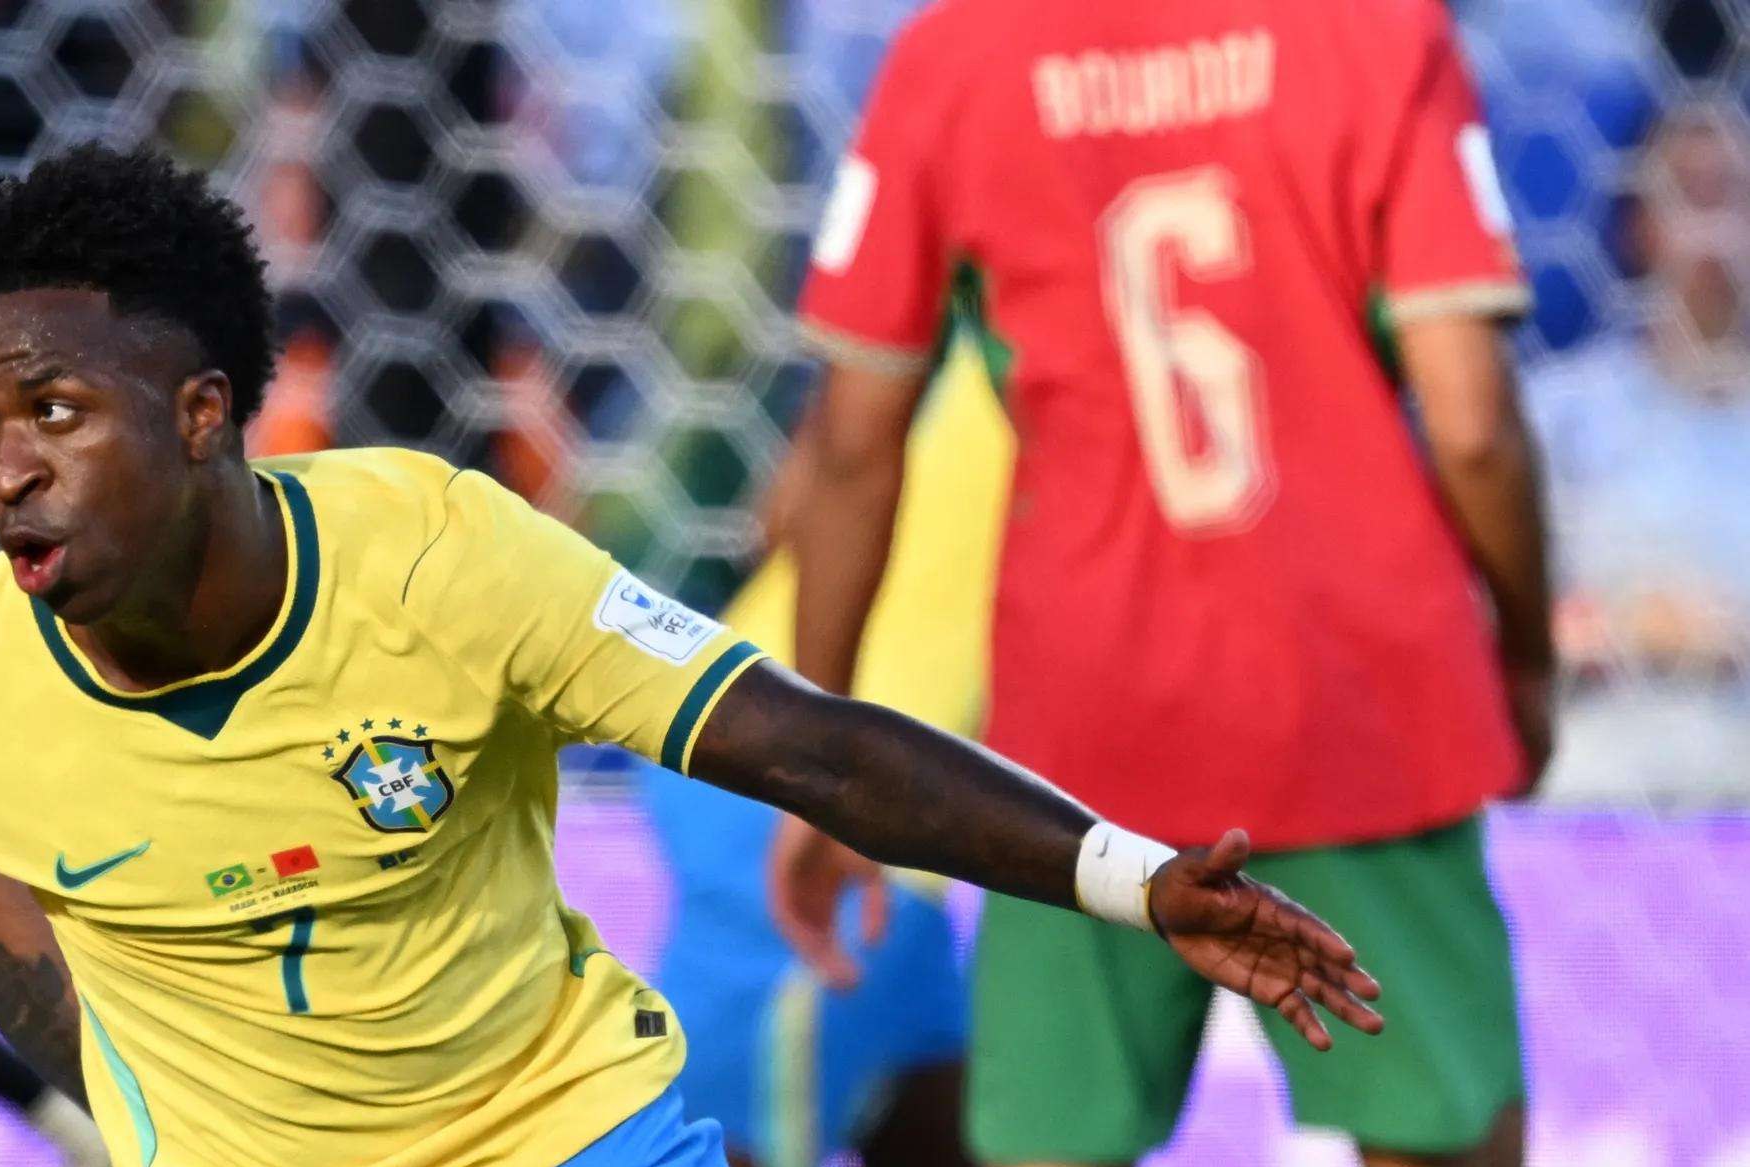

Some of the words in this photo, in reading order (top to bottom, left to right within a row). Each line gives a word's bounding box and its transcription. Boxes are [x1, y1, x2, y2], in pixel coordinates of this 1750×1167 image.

[1093, 163, 1280, 541] 6
[378, 774, 414, 797] CBF
[251, 904, 317, 1014] 7
